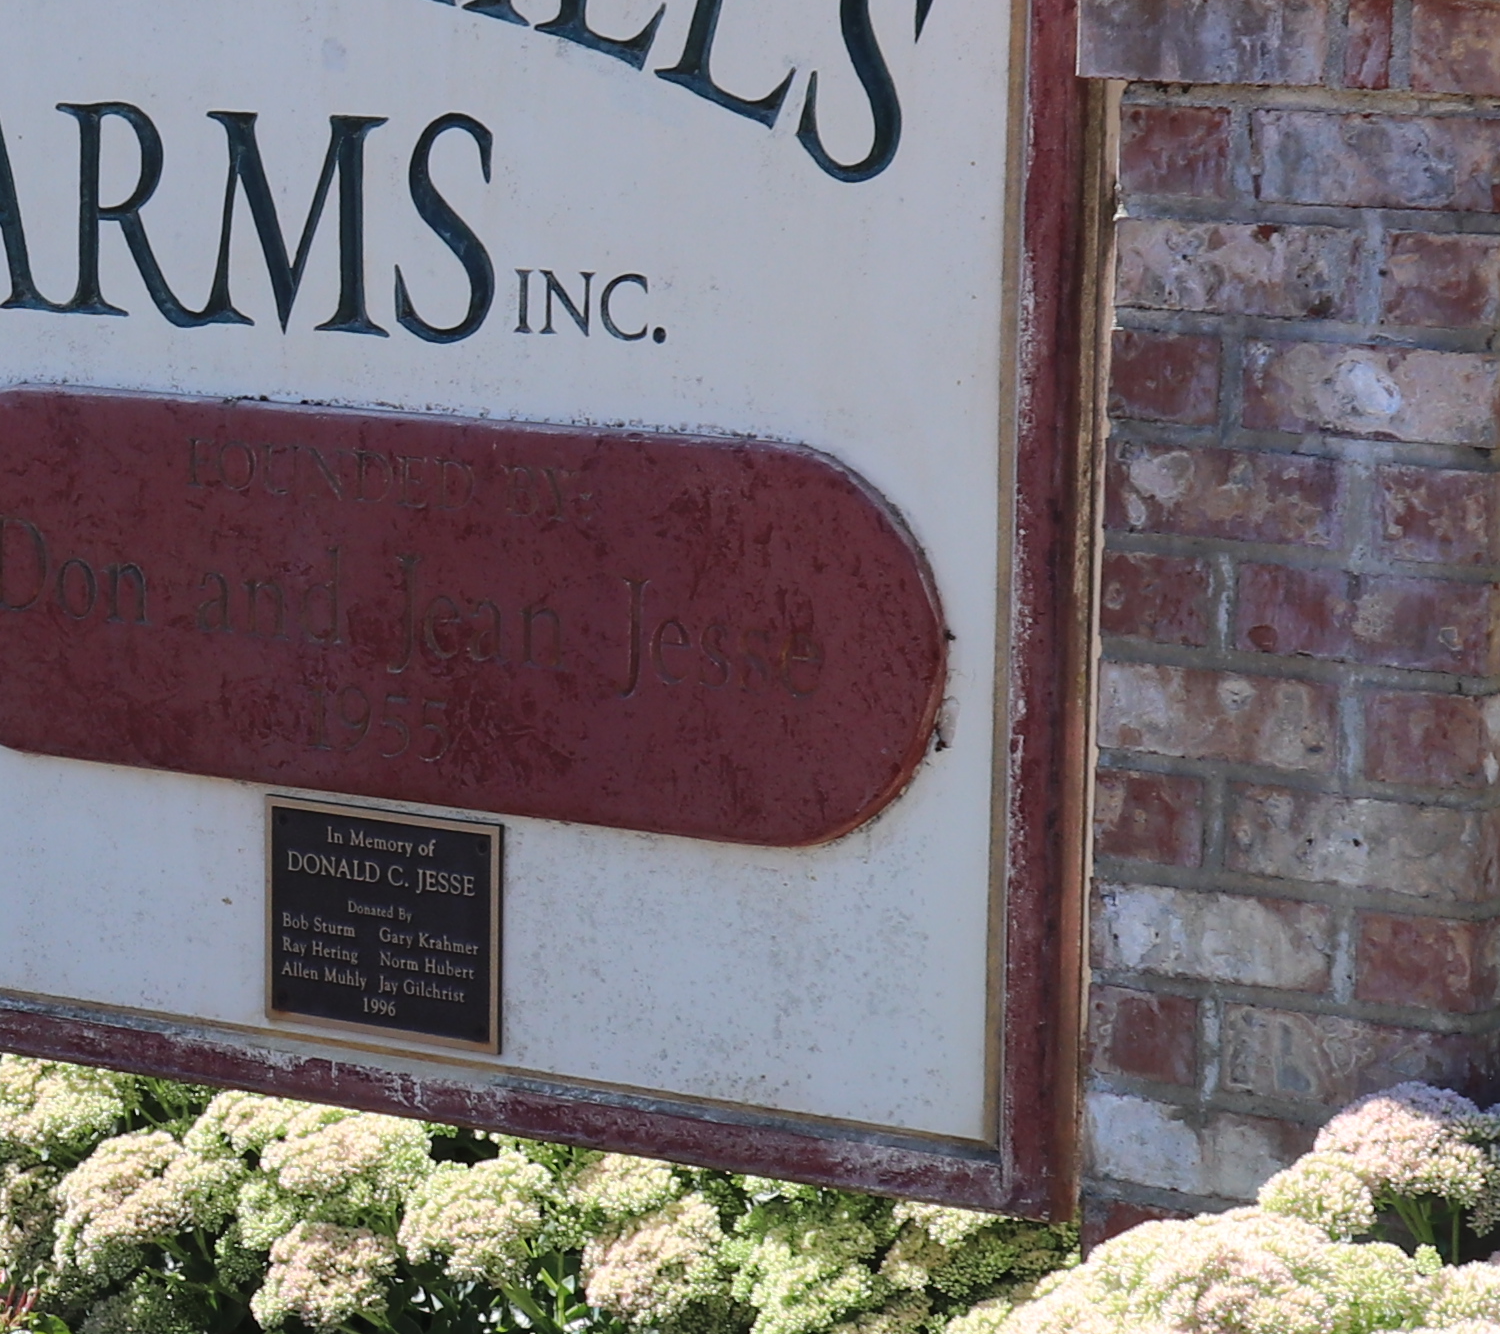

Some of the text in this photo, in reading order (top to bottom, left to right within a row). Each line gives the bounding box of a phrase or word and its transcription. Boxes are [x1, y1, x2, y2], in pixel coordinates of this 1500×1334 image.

[512, 269, 668, 345] INC.
[186, 436, 475, 513] FOUNDED
[195, 548, 344, 648] and
[387, 553, 566, 675] Jean
[615, 577, 828, 701] Jesse
[310, 685, 452, 763] 1955
[327, 826, 436, 857] In Memory of
[287, 851, 476, 897] DONALD C. JESSE
[282, 913, 355, 938] Bob Sturm
[348, 900, 412, 923] Donated By
[282, 937, 358, 964] Ray Hering
[379, 928, 479, 956] Gary Krahmer
[281, 962, 367, 990] Allen Muhly
[379, 951, 474, 980] Norm Hubert
[379, 976, 465, 1003] Jay Gilchrist
[362, 998, 396, 1017] 1996
